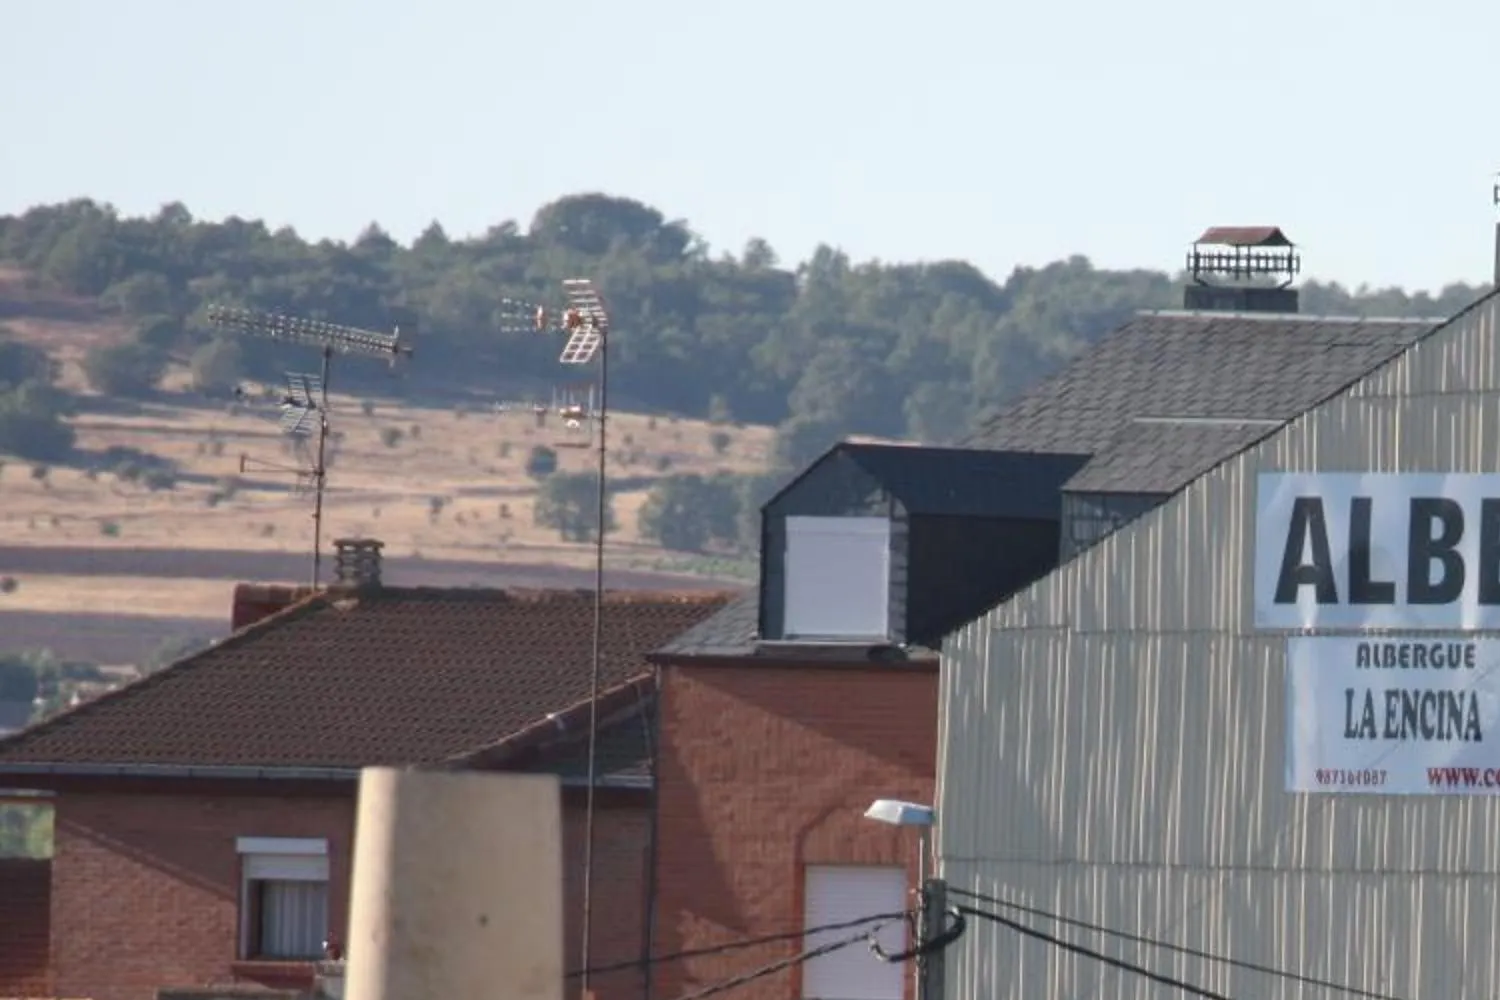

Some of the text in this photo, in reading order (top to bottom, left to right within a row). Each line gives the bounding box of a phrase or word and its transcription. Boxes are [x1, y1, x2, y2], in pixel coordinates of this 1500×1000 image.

[1355, 642, 1477, 669] ALBERGUE
[1343, 687, 1483, 743] LA ENCINA
